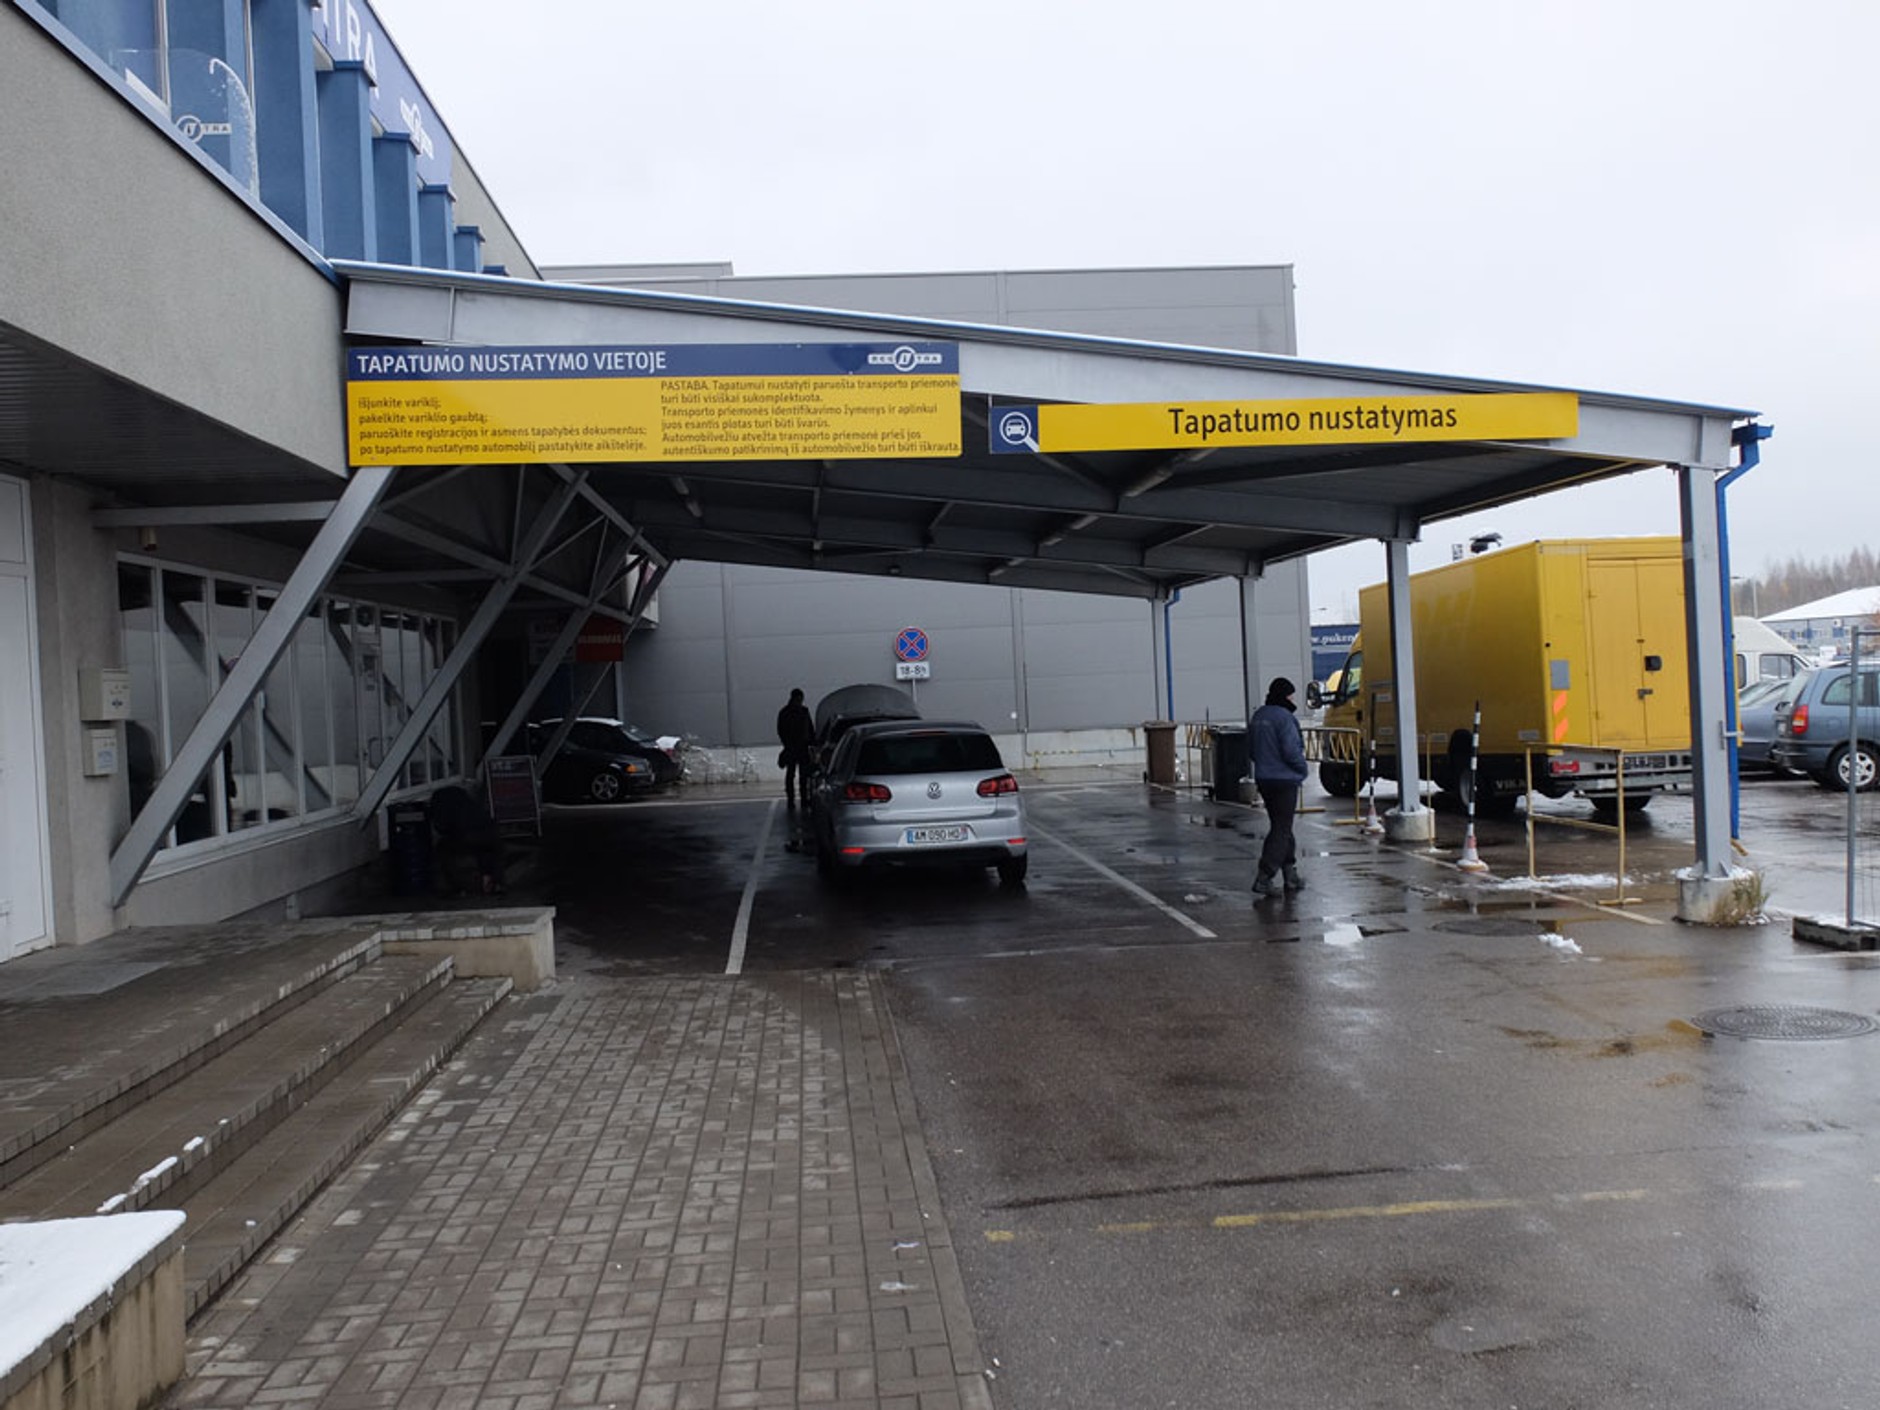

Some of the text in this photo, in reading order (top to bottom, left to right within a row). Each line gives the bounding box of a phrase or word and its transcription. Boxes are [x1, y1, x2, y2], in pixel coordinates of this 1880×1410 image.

[356, 351, 667, 374] TAPATUMO NUSTATYMO VIETOJE
[712, 380, 765, 392] Tapatumui
[767, 380, 810, 392] nustatyti
[812, 379, 855, 392] paruošta
[857, 379, 909, 391] transporto
[660, 394, 679, 403] turi
[703, 393, 740, 403] visiškai
[742, 392, 823, 405] sukomplektuota.
[661, 406, 716, 418] Transporto
[771, 404, 842, 416] identifikavimo
[888, 404, 897, 414] ir
[898, 403, 938, 415] aplinkui
[359, 412, 405, 426] pakelkite
[408, 412, 448, 423] variklio
[661, 420, 683, 432] juos
[685, 420, 719, 430] esantis
[721, 418, 752, 431] plotas
[754, 418, 772, 429] turi
[1168, 404, 1458, 441] Tapatumo nustatymas
[359, 428, 413, 442] paruoškite
[415, 426, 479, 440] registracijos
[481, 426, 490, 436] ir
[491, 428, 530, 437] asmens
[779, 431, 831, 443] transporto
[907, 429, 922, 442] jos
[360, 446, 374, 457] po
[375, 443, 424, 456] tapatumo
[426, 442, 479, 456] nustatymo
[538, 440, 594, 454] pastatykite
[878, 441, 896, 452] turi
